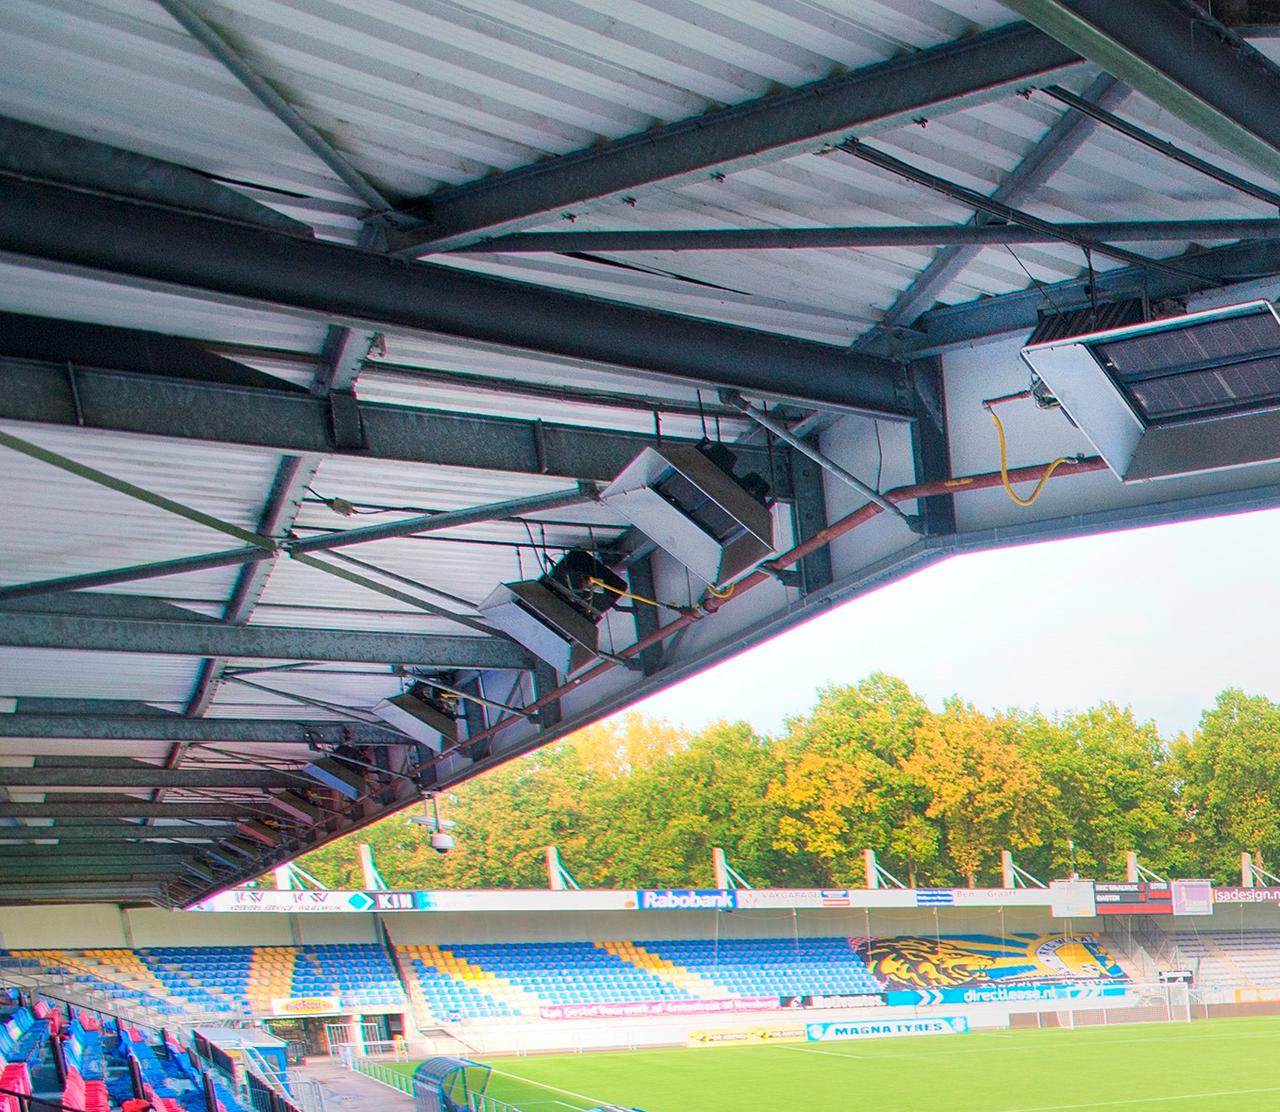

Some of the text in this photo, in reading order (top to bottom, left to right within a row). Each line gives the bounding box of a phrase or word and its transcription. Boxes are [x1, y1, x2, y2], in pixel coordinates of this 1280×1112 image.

[644, 891, 734, 908] Rabobank
[834, 1023, 943, 1037] MAGNA TYRES
